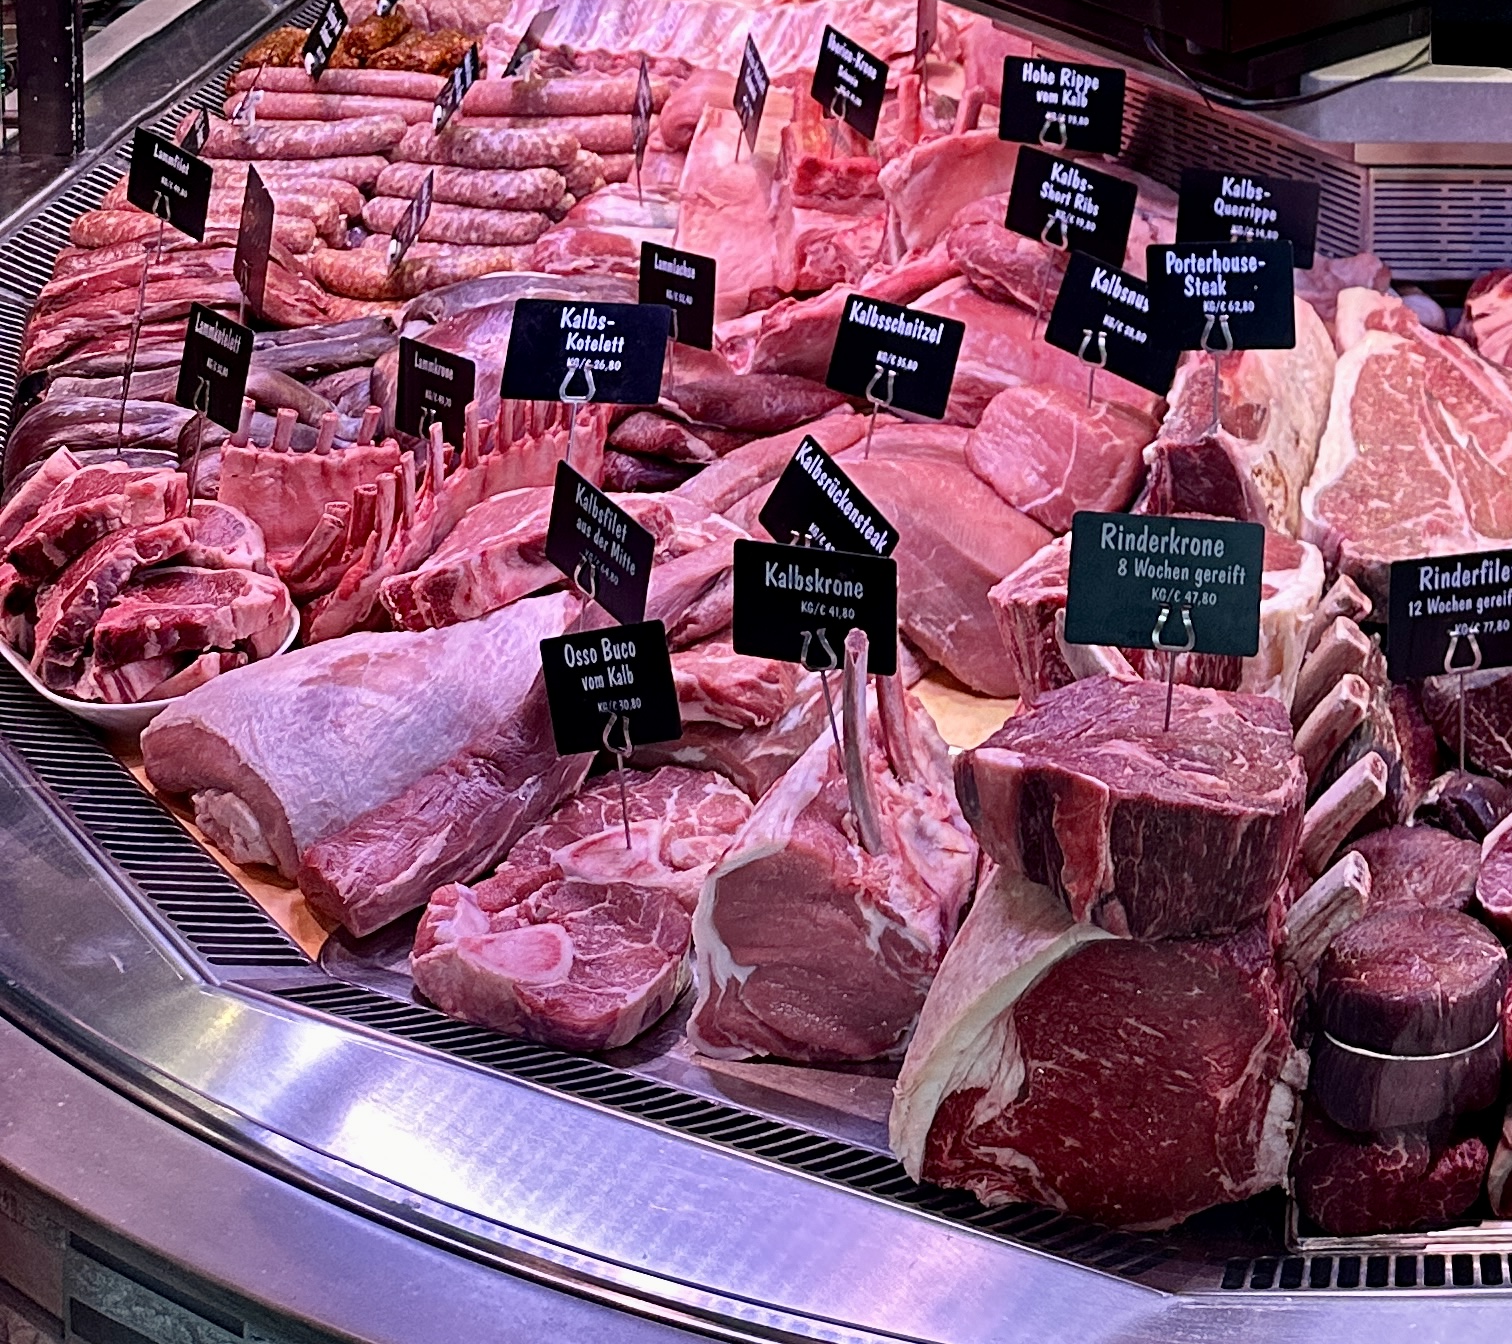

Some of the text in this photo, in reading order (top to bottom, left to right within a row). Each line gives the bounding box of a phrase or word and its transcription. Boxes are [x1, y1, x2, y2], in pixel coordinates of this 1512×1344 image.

[1022, 62, 1100, 94] Hohe Rippe
[1062, 88, 1088, 108] Kalb
[1050, 162, 1094, 193] Kalbs-
[1222, 176, 1271, 201] Kalbs-
[1040, 181, 1100, 217] Short Ribs
[1213, 198, 1277, 223] Querrippe
[1165, 249, 1266, 275] Porterhouse-
[1184, 274, 1227, 298] Steak
[560, 306, 616, 331] Kalbs-
[849, 300, 945, 346] Kalbsschnitzel
[565, 332, 625, 355] Kotelett
[594, 358, 622, 372] 26,80
[796, 441, 888, 554] Kalbsrückensteak
[575, 482, 627, 543] Kalbsfilet
[576, 517, 636, 576] aus der Mitte
[1101, 522, 1226, 558] Rinderkrone
[765, 561, 864, 600] Kalbskrone
[1118, 557, 1246, 588] 8 Wochen gereift
[801, 600, 855, 620] KG/€ 41,80
[1151, 587, 1217, 606] KG/€ 47,80
[1408, 600, 1422, 617] 12
[1427, 594, 1472, 615] Wochen
[1483, 618, 1511, 633] 77,80
[564, 636, 637, 668] Osso Buco
[581, 664, 634, 692] vom Kalb
